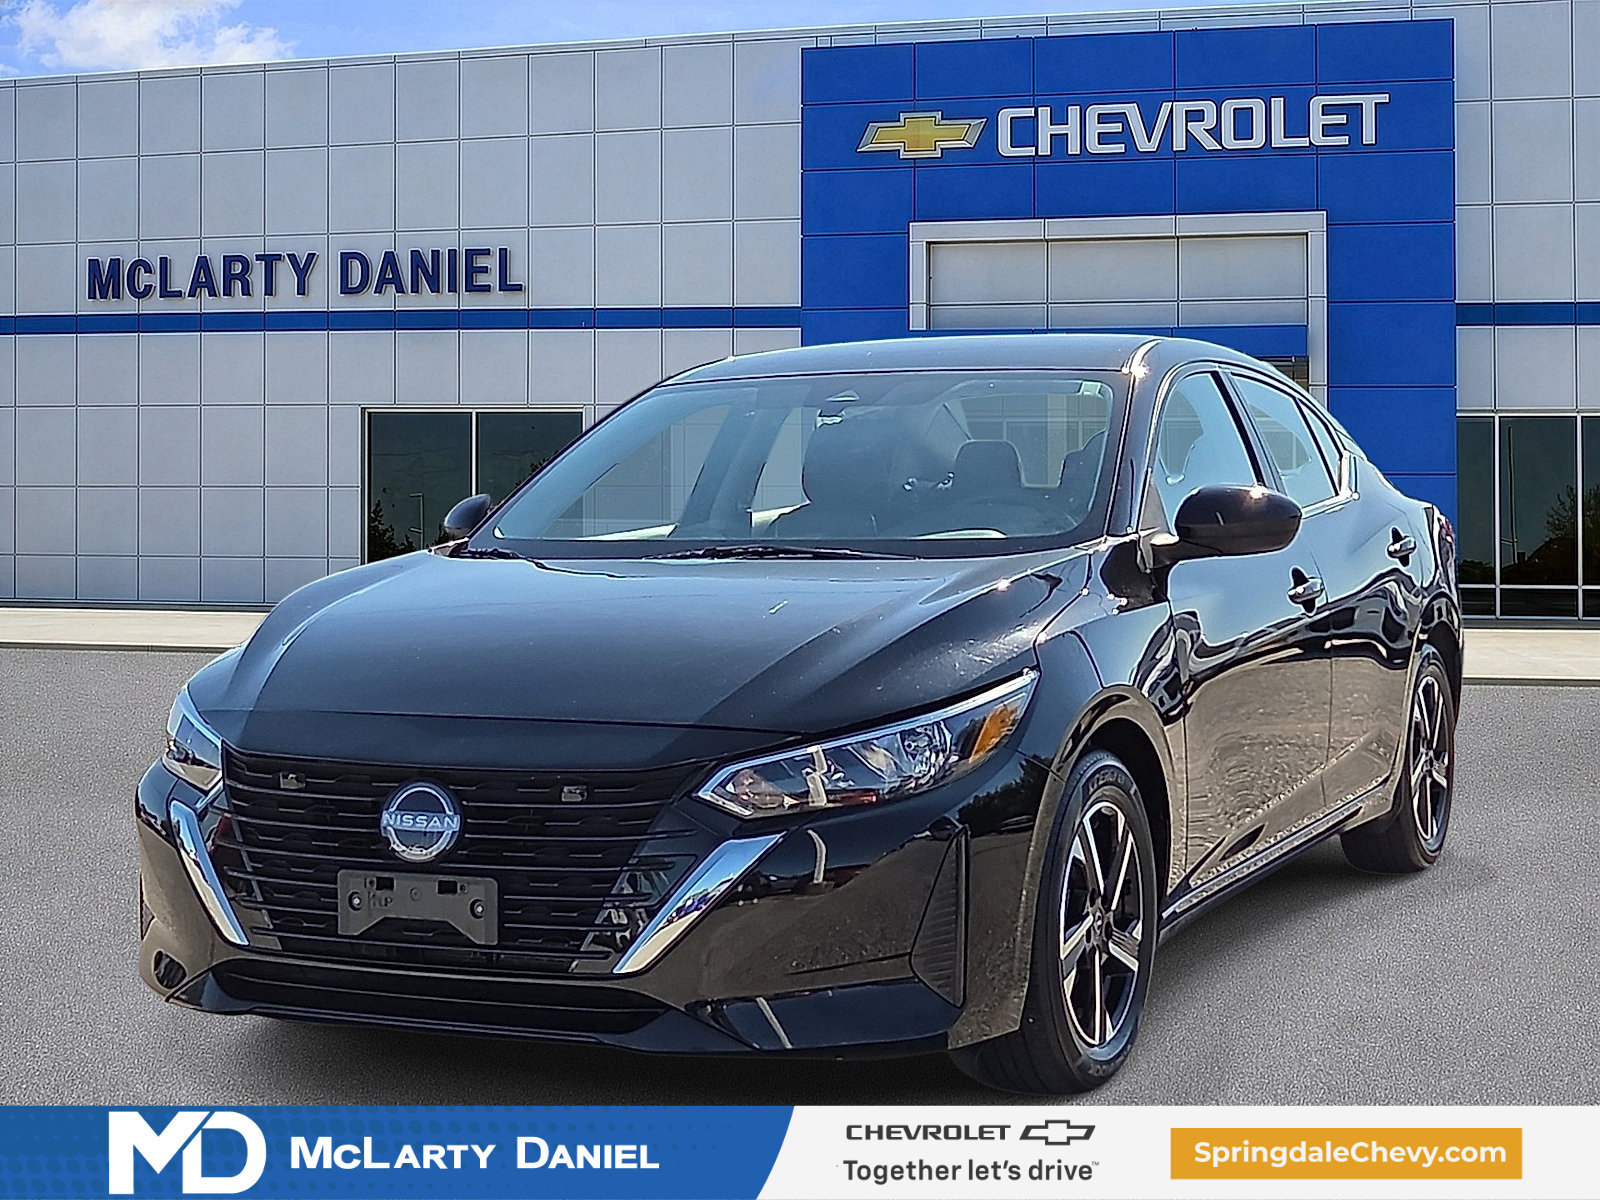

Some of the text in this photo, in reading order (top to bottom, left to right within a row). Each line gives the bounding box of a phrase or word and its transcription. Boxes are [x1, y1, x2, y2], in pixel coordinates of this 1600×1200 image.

[998, 94, 1390, 156] CHEVROLET
[339, 246, 525, 295] DANIEL
[382, 813, 459, 829] NISSAN
